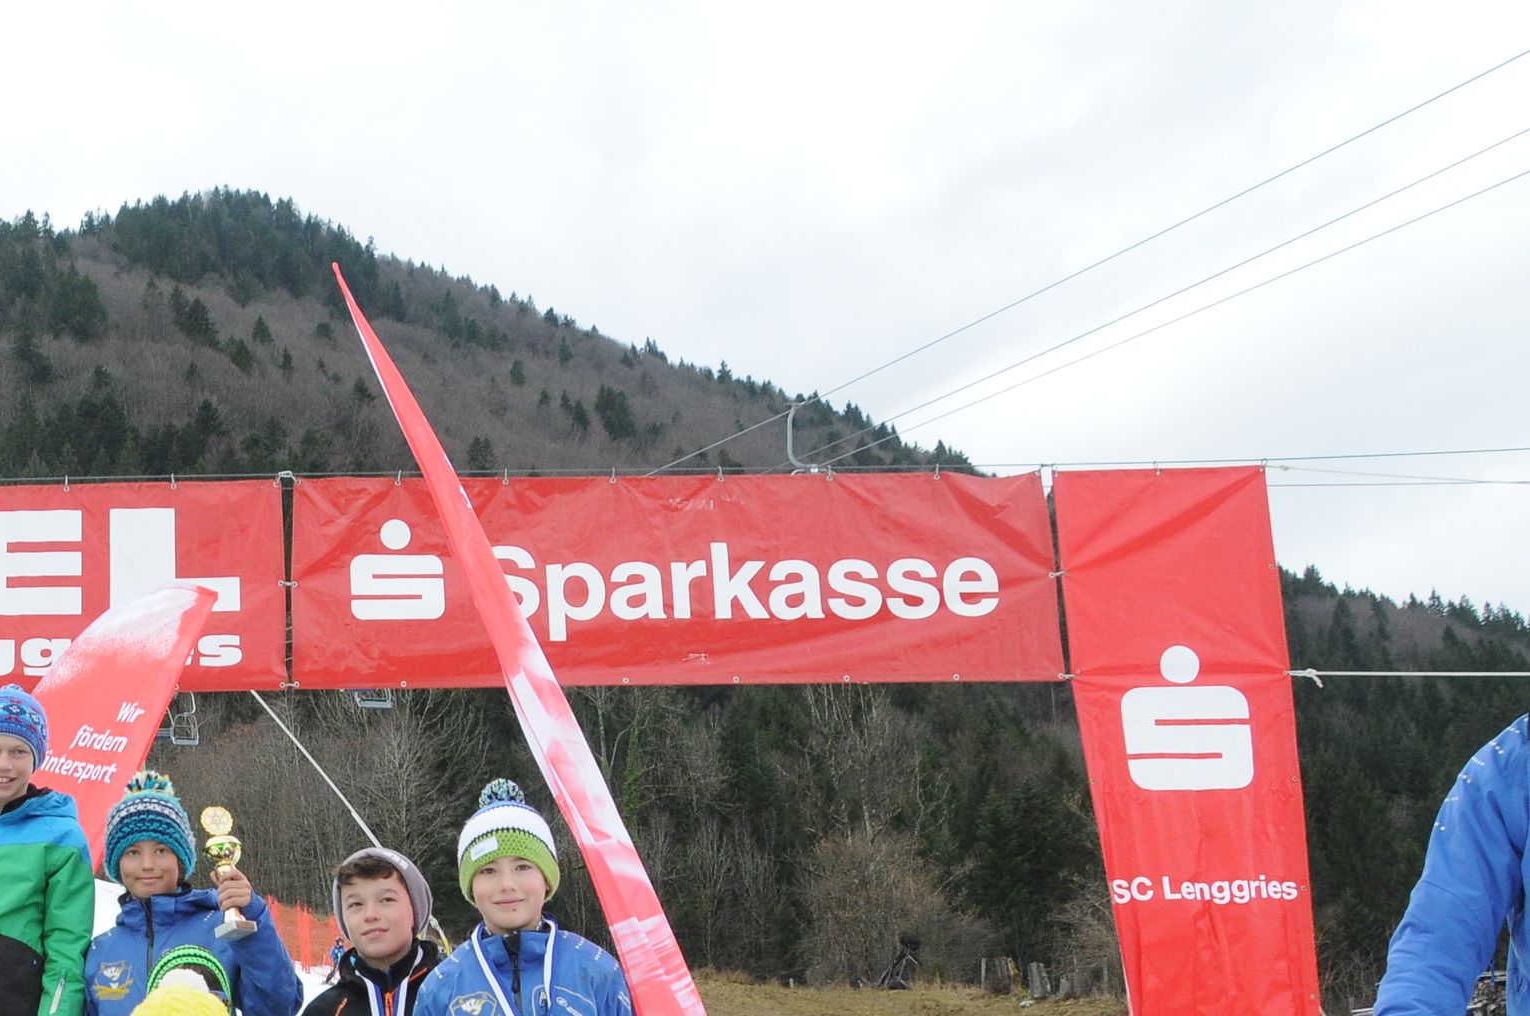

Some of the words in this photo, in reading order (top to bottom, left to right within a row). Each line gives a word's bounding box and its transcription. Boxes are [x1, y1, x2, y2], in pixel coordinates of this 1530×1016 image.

[493, 542, 1000, 642] Sparkasse
[117, 701, 145, 723] Wir
[70, 724, 128, 753] fördern
[40, 751, 118, 784] intersport
[1111, 877, 1154, 904] SC
[1162, 874, 1299, 905] Lenggries
